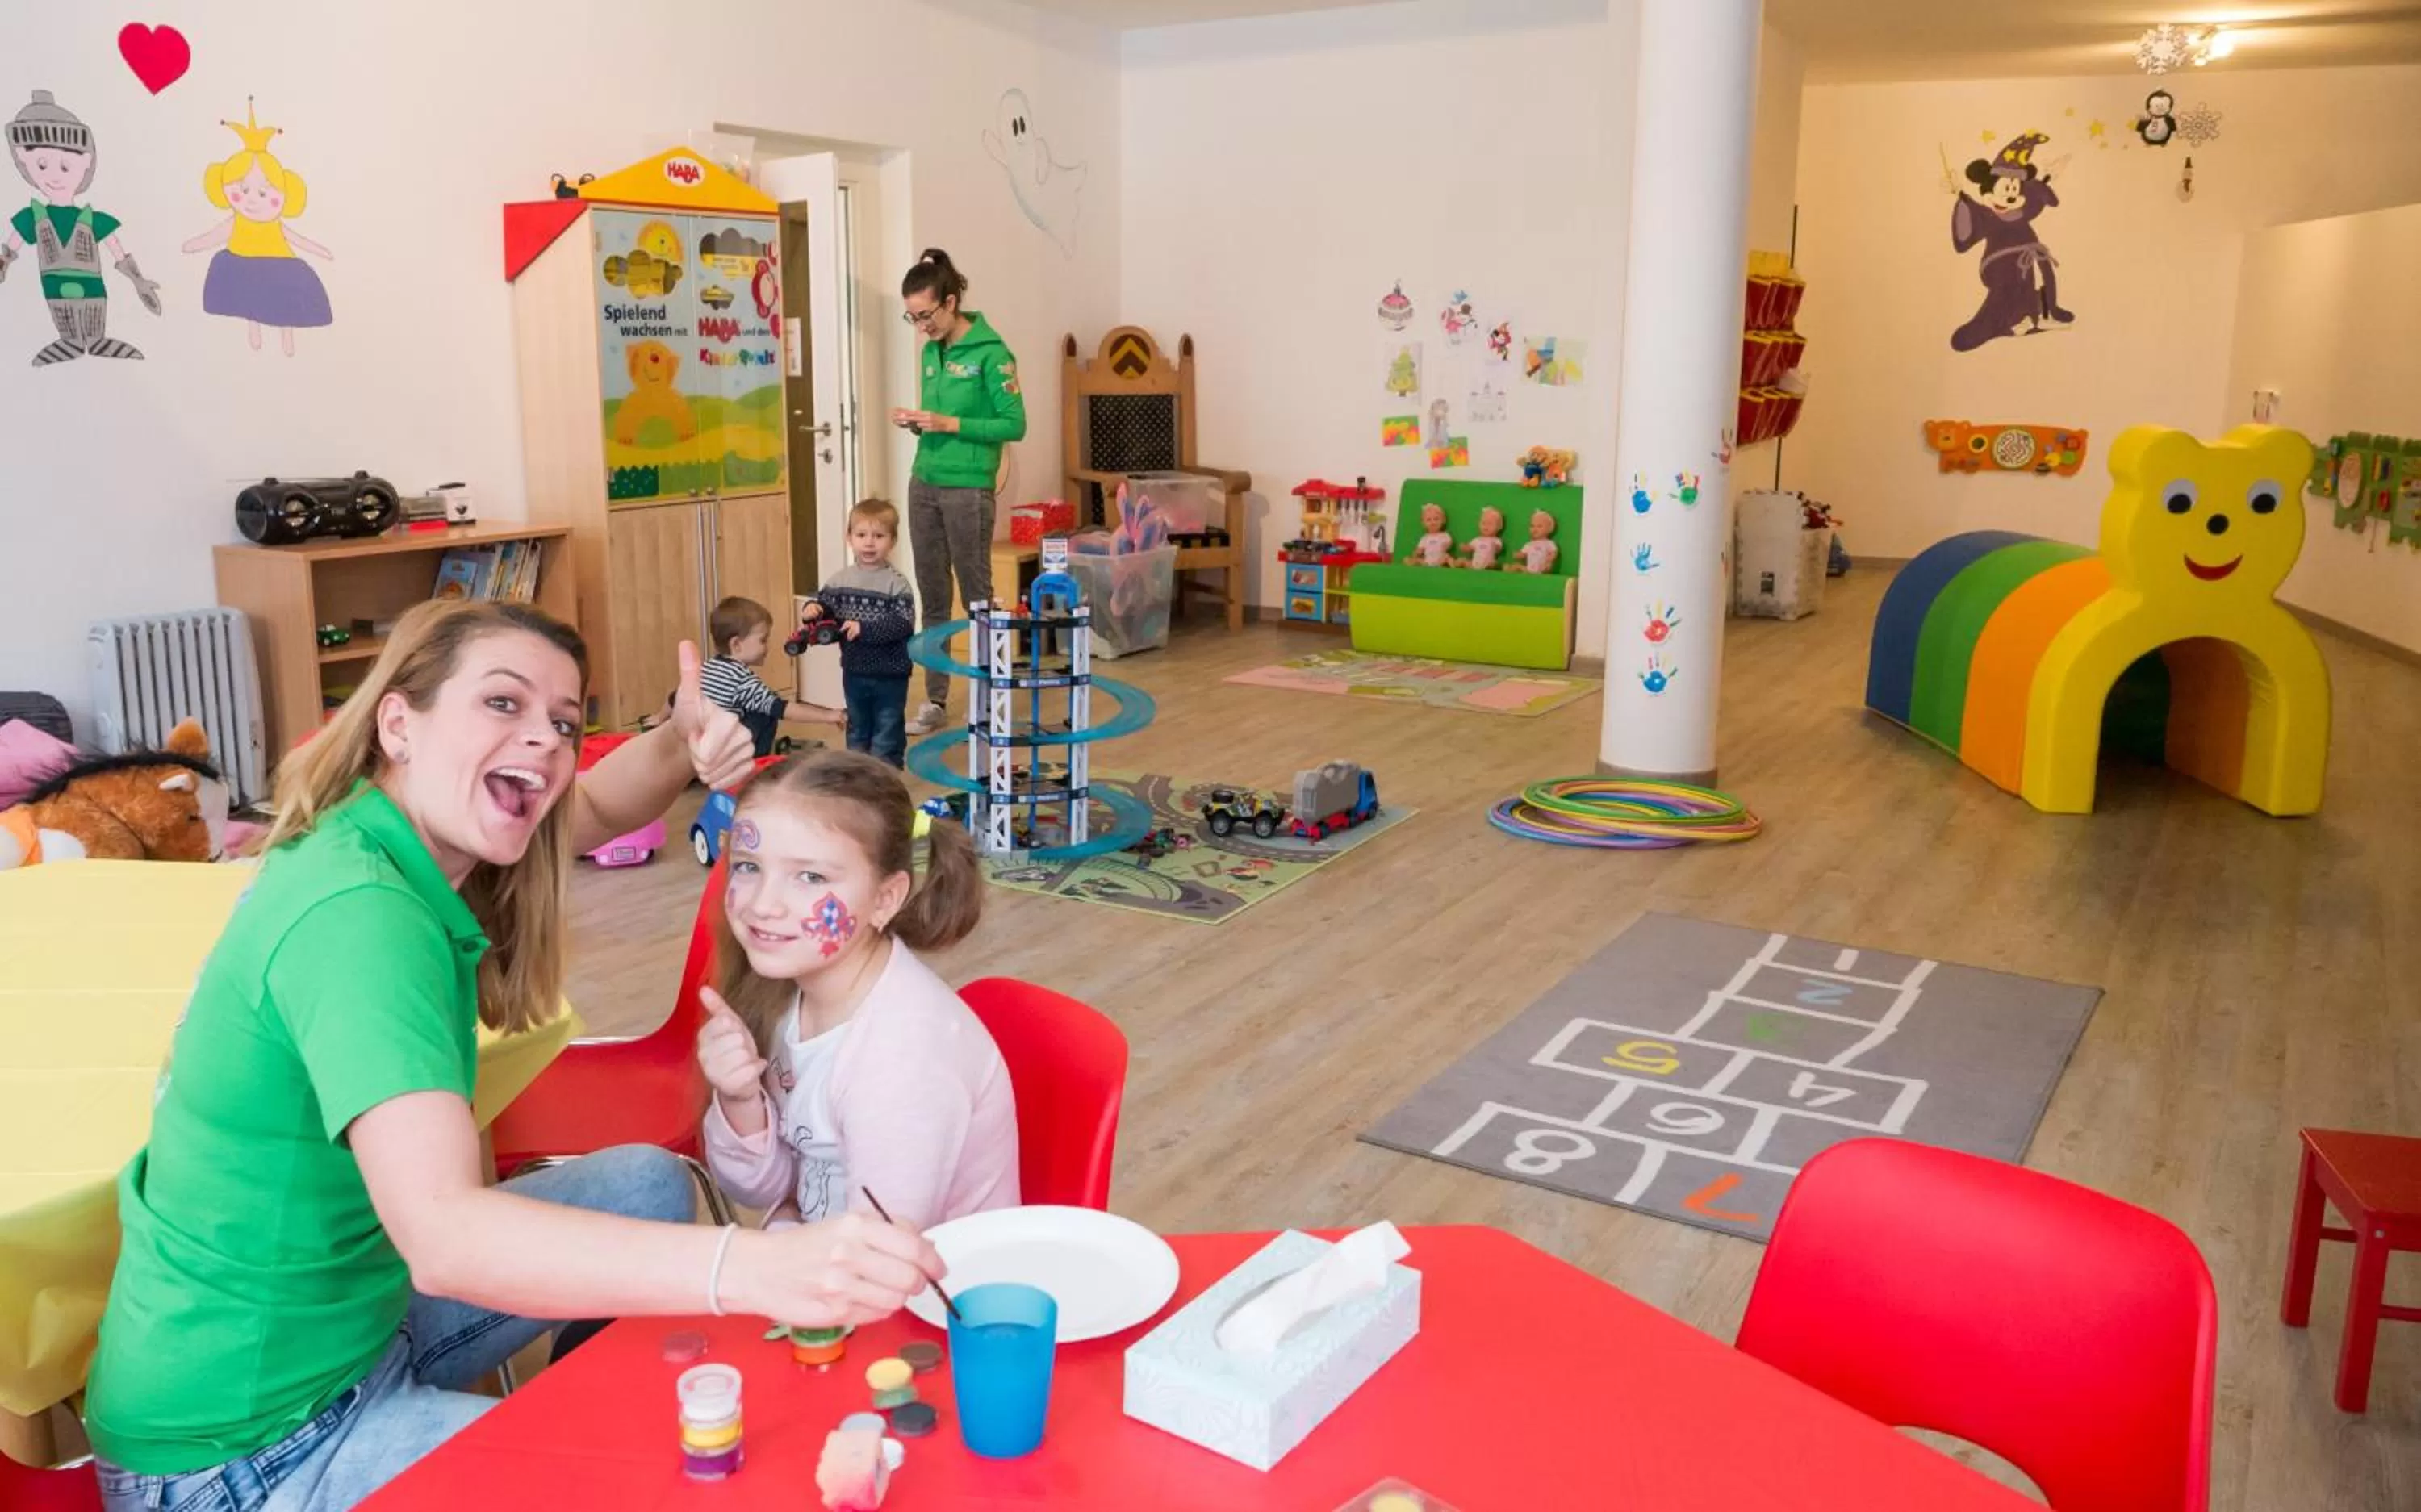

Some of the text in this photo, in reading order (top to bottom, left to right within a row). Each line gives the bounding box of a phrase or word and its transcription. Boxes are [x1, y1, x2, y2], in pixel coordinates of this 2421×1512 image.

[667, 161, 700, 184] HABA
[604, 303, 667, 324] Spielend
[621, 323, 673, 336] wachsen
[675, 327, 688, 336] mit
[699, 316, 741, 344] HABA
[742, 326, 756, 336] und
[1796, 979, 1854, 1005] 2
[1601, 1040, 1680, 1076] 5
[1788, 1071, 1856, 1107] 4
[1645, 1101, 1725, 1135] 6
[1504, 1129, 1597, 1175] 8
[1682, 1172, 1760, 1223] 7
